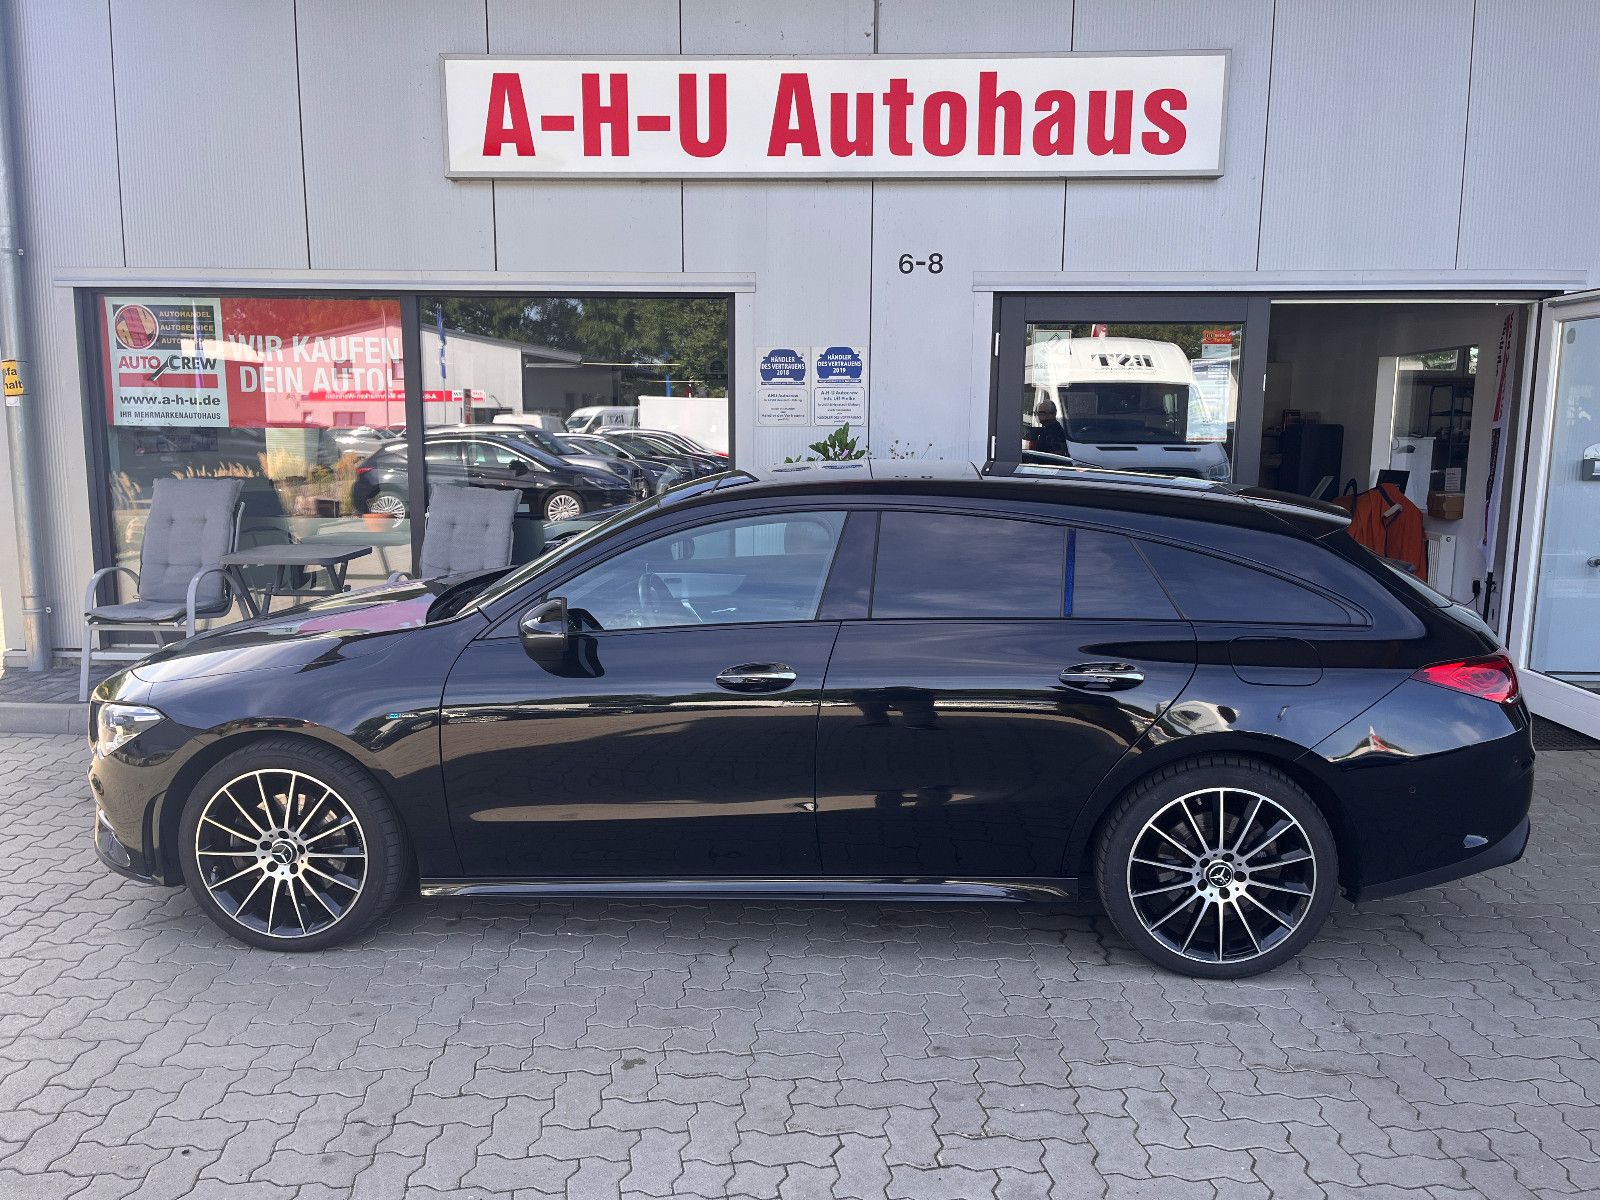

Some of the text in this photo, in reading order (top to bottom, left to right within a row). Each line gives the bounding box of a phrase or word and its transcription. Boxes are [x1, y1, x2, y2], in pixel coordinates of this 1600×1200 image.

[482, 71, 1188, 159] A-H-U Autohaus
[899, 252, 944, 274] 6-8
[159, 310, 211, 318] AUTOHANDEL
[160, 324, 214, 332] AUTOSERVICE
[228, 334, 401, 364] WIR KAUFEN
[118, 355, 217, 370] AUTO CREW
[239, 365, 394, 393] DEIN AUTO!
[120, 394, 221, 406] www.a-h-u.de
[120, 410, 221, 420] IHR MEHRMARKENAUTOHAUS
